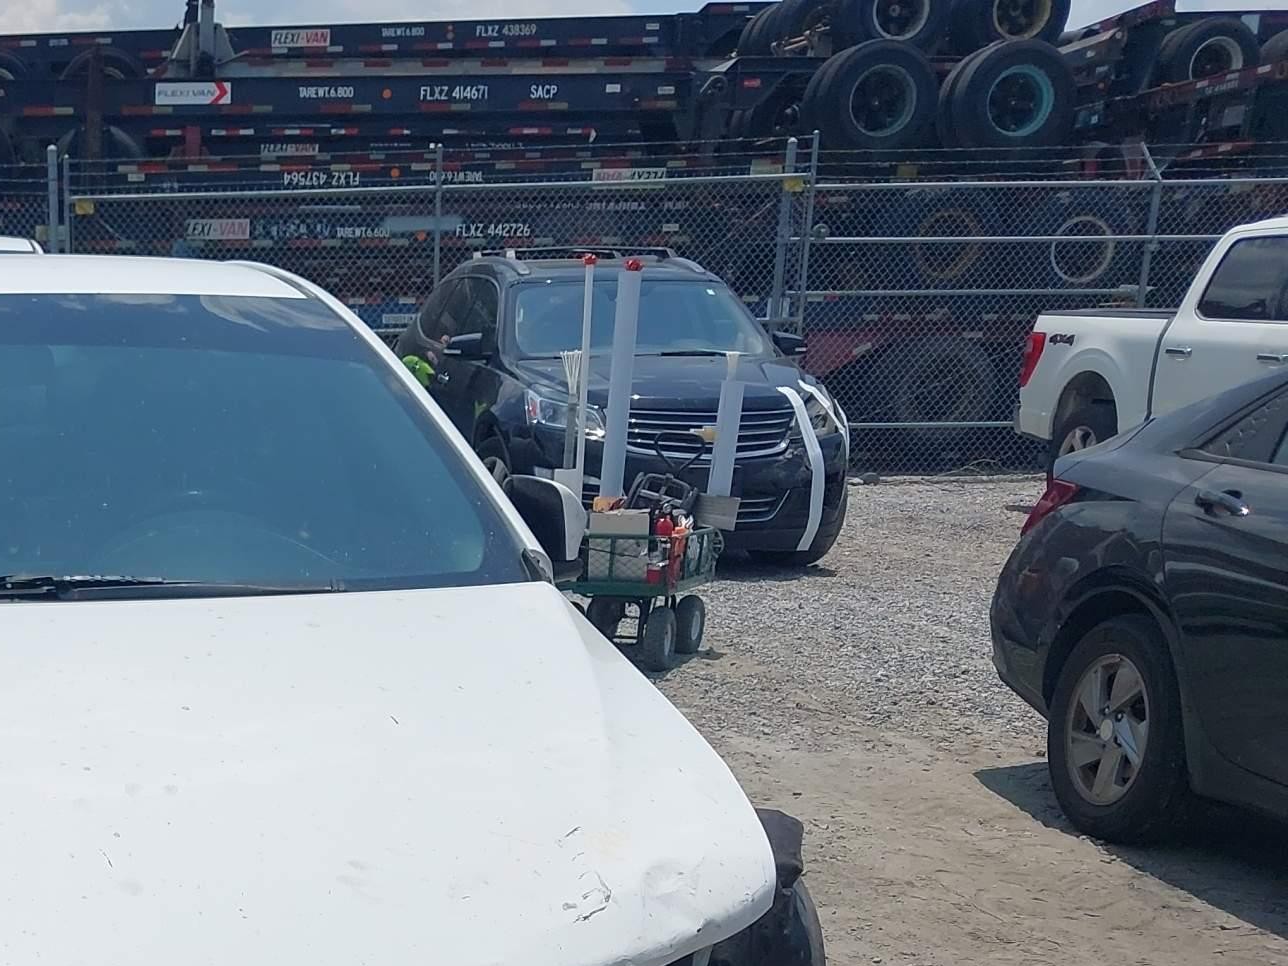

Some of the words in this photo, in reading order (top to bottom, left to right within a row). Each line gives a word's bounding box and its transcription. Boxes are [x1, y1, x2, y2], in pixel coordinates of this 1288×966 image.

[273, 31, 329, 45] FLEXI-VAN
[476, 25, 499, 37] FLXZ
[420, 86, 448, 100] FLXZ
[452, 85, 488, 100] 414671
[530, 84, 558, 99] SACP
[283, 171, 327, 186] 437564
[332, 171, 360, 186] FLXZ
[456, 223, 484, 237] FLXZ
[488, 223, 531, 237] 442726
